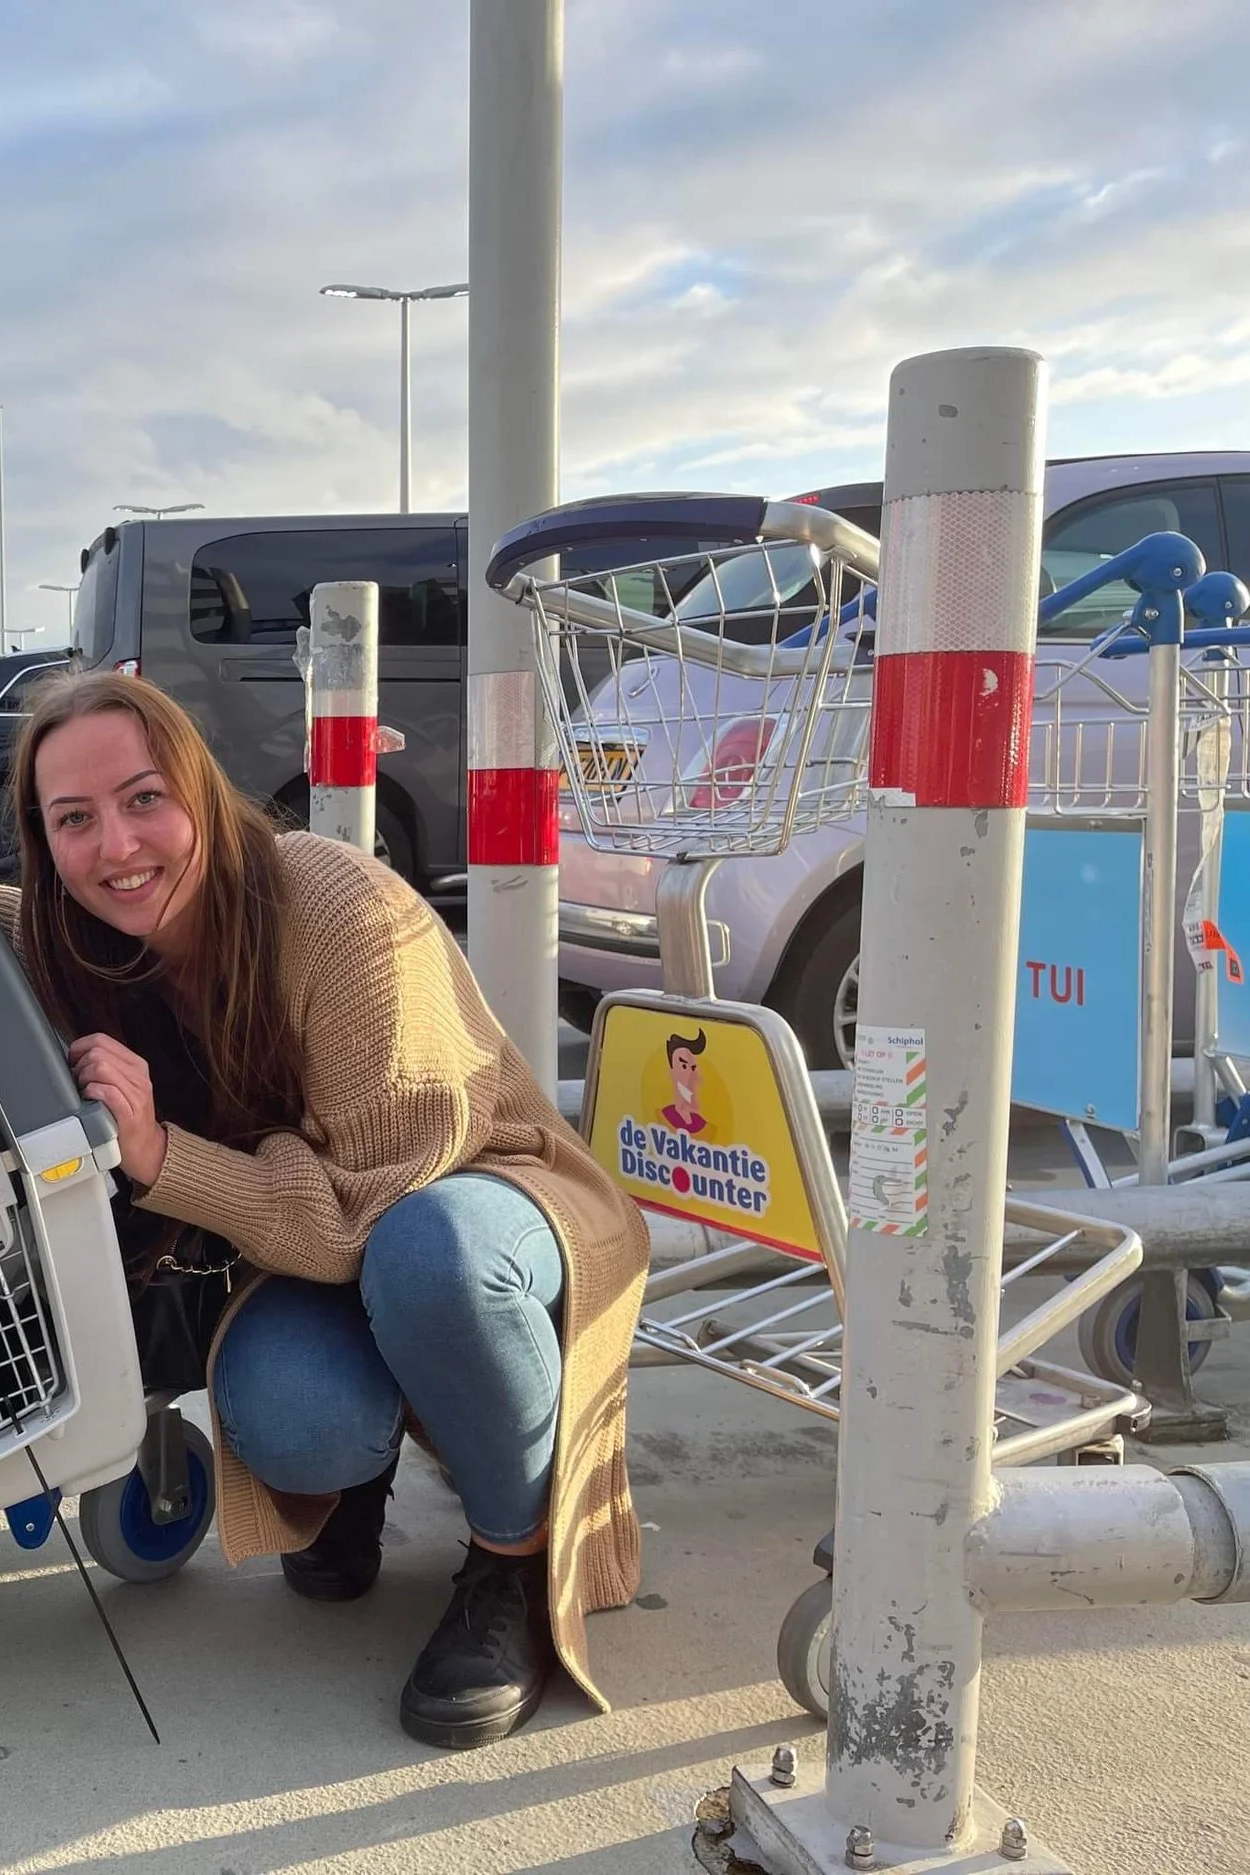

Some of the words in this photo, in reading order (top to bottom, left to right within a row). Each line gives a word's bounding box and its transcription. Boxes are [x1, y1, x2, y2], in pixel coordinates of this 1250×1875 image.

[1026, 961, 1086, 1007] TUI
[887, 1036, 924, 1046] Schiphol
[620, 1120, 647, 1151] de
[650, 1128, 766, 1183] Vakantie
[621, 1149, 767, 1213] Discounter
